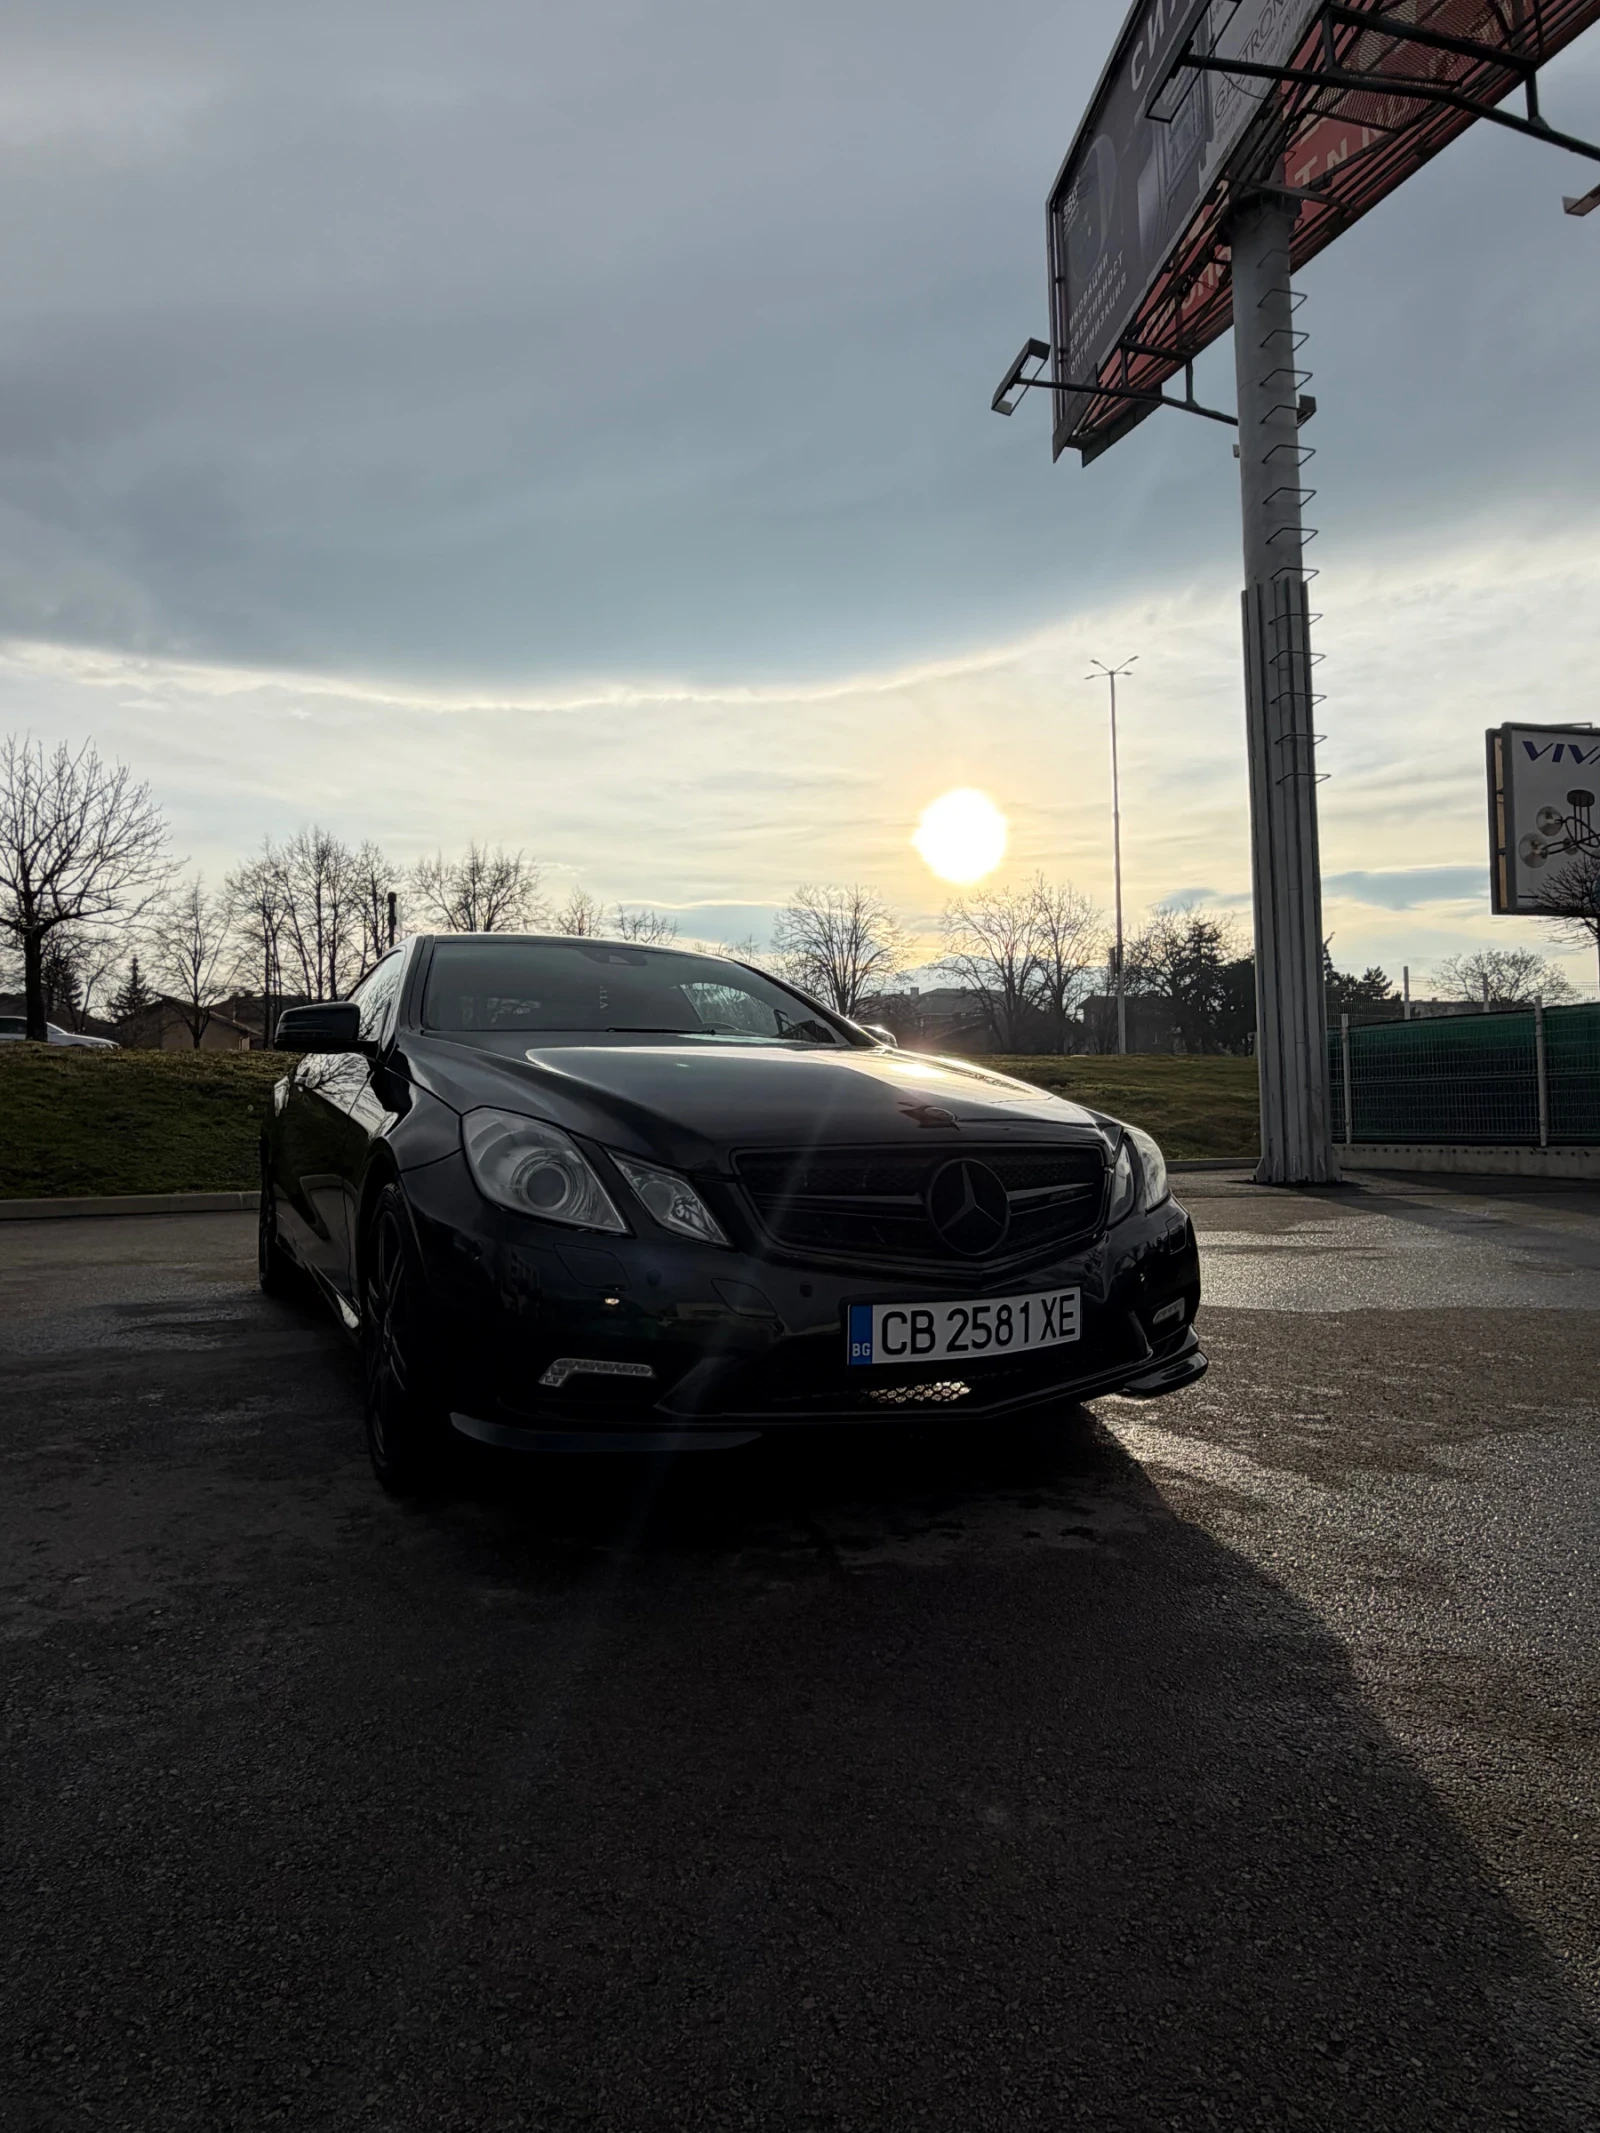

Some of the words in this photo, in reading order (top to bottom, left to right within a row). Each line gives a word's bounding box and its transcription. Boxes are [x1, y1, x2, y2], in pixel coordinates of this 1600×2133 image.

[1068, 251, 1109, 332] ИНОВАЦИИ
[1069, 249, 1123, 356] ЕФЕКТИВНОСТ
[1070, 271, 1127, 375] ОПТИМИЗАЦИЯ
[851, 1342, 871, 1357] BG
[881, 1309, 936, 1356] CB
[946, 1301, 1030, 1352] 2581
[1040, 1293, 1076, 1341] XE
